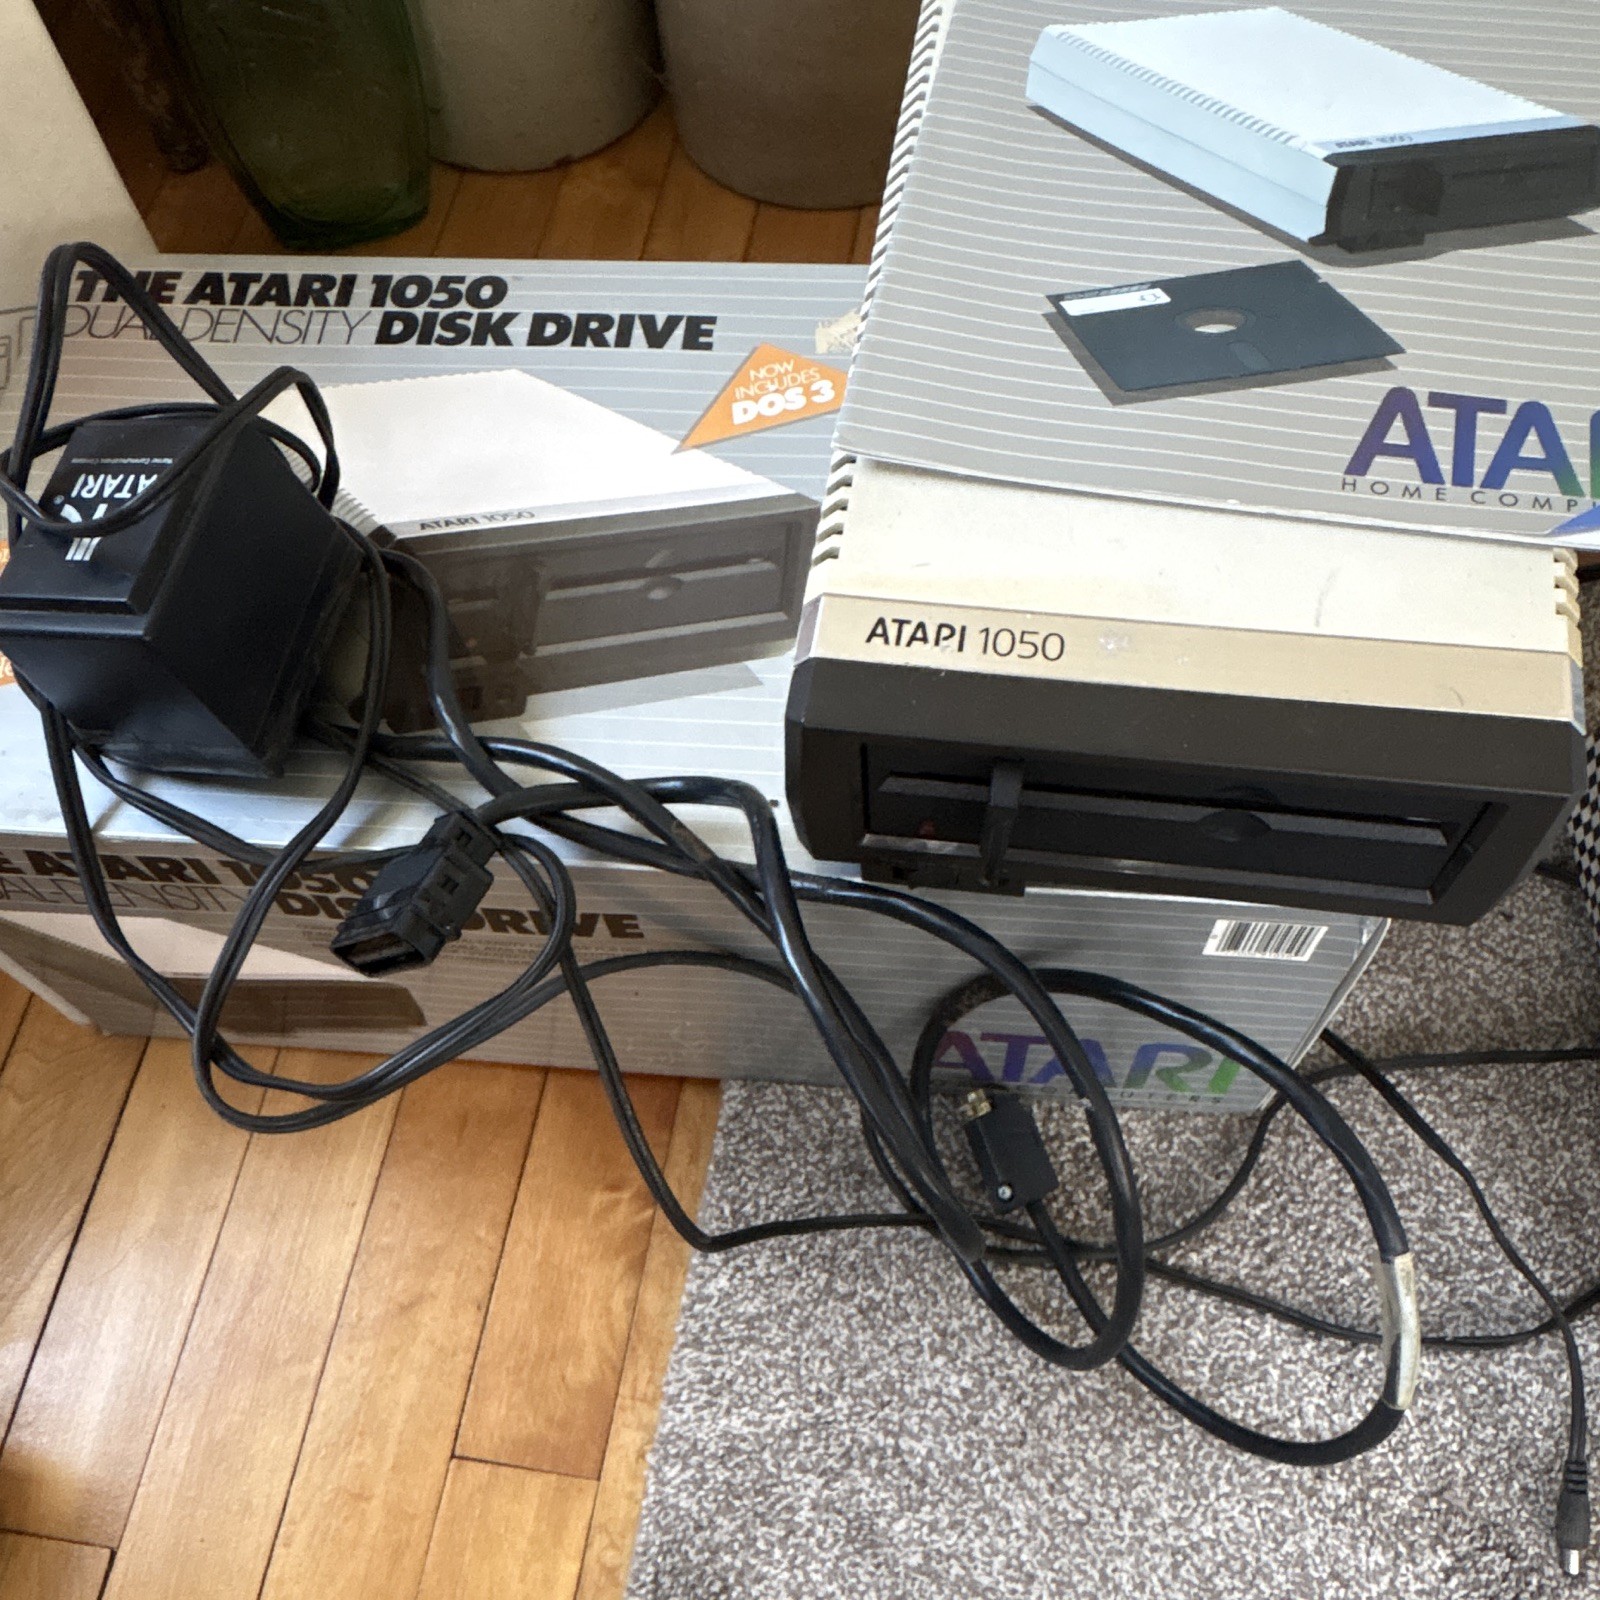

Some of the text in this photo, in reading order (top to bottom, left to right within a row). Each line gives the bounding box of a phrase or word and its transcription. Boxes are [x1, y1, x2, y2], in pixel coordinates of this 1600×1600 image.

[182, 272, 358, 307] ATARI
[370, 274, 508, 309] 1050
[375, 311, 521, 346] DISK
[526, 312, 717, 351] DRIVE
[749, 359, 795, 381] NOW
[732, 379, 836, 425] DOS 3
[1344, 386, 1600, 500] ATA
[71, 473, 158, 499] ATARI
[1341, 477, 1447, 501] HOME
[979, 627, 1065, 661] 1050
